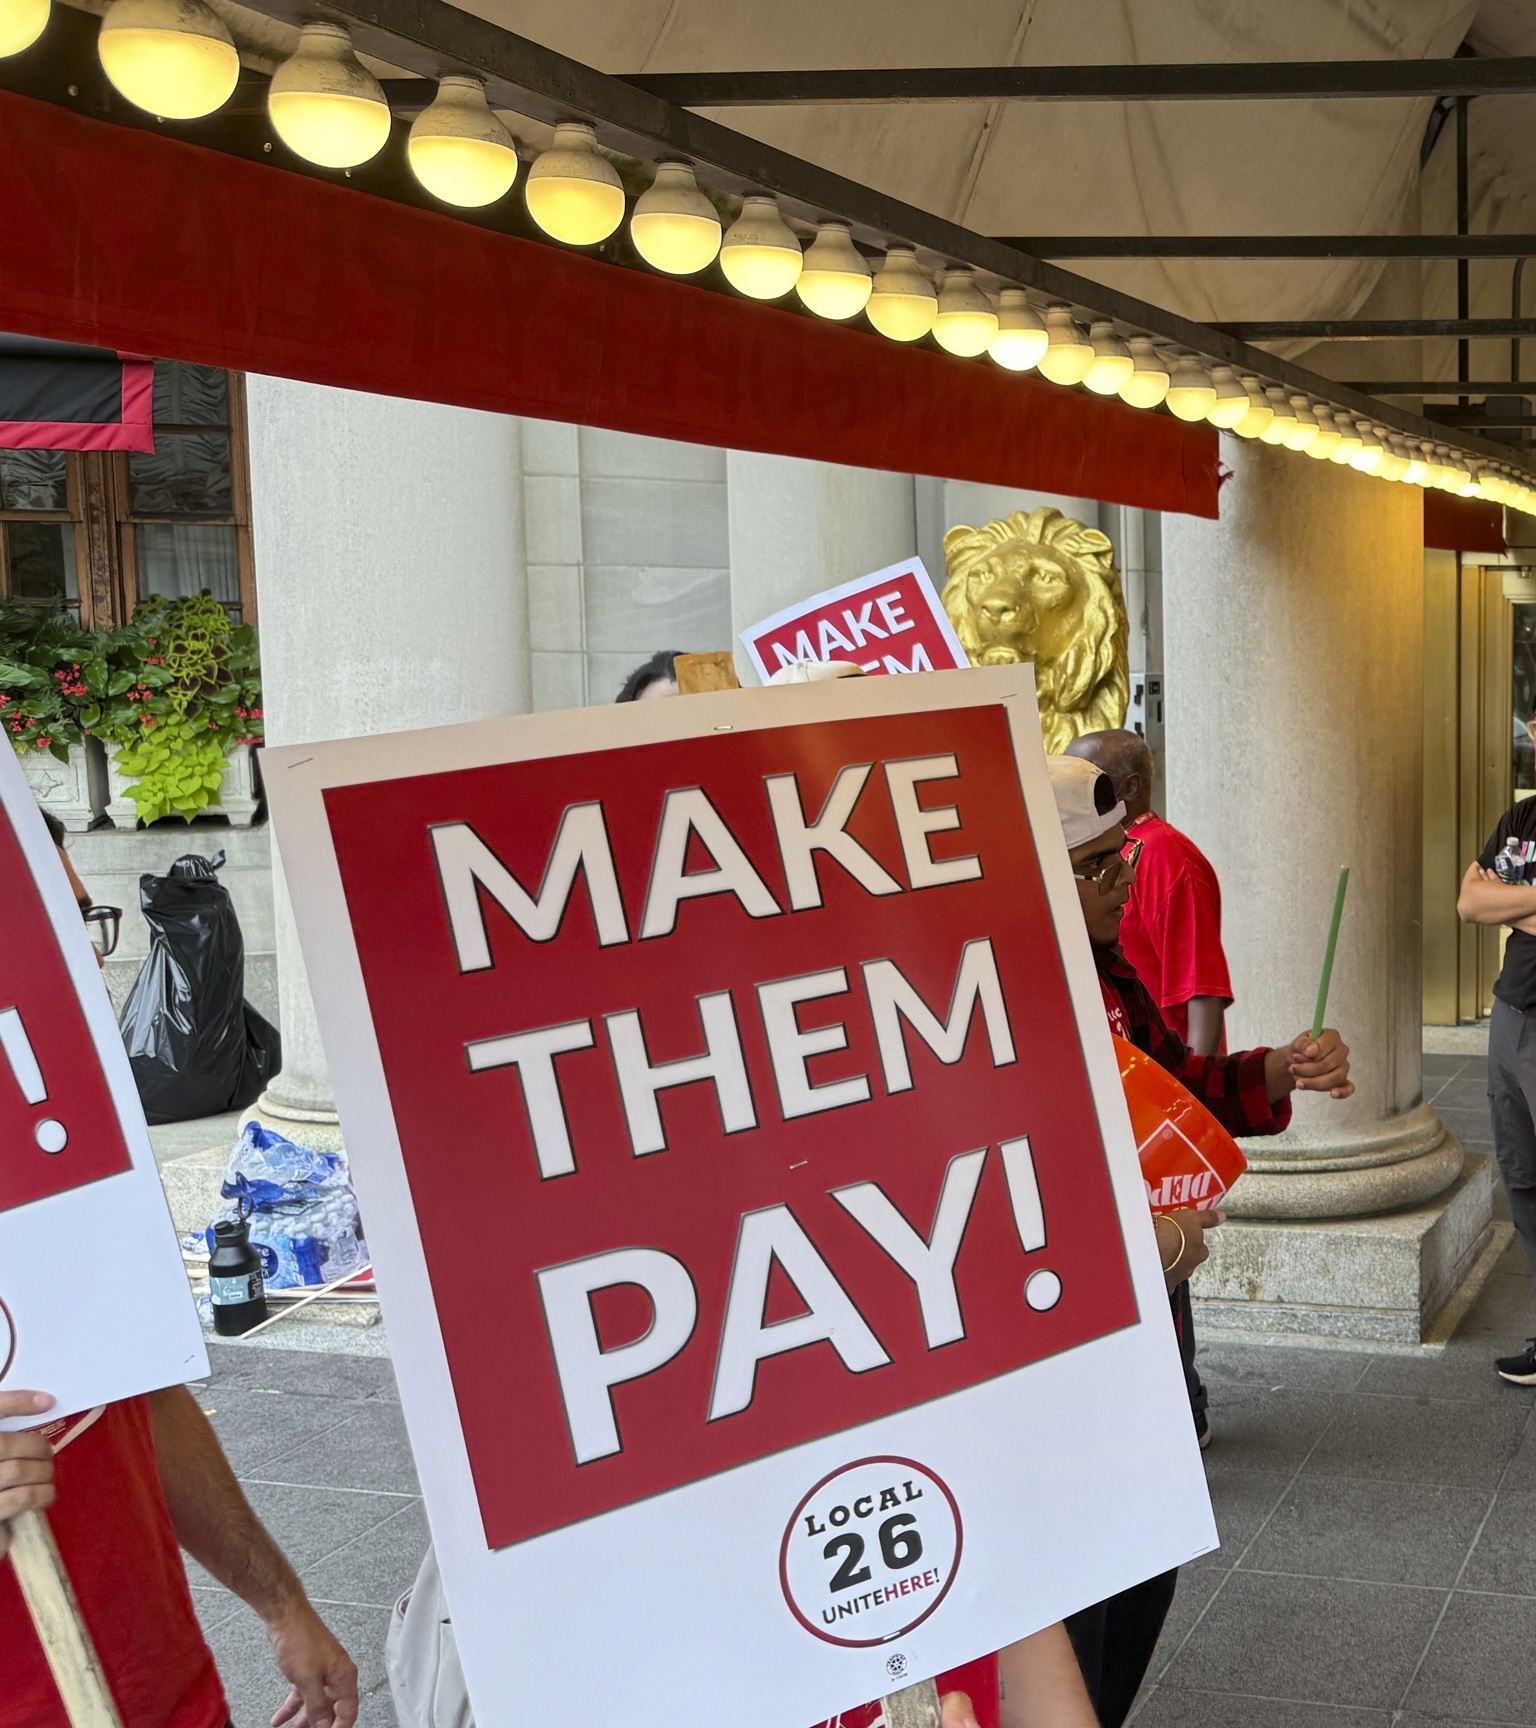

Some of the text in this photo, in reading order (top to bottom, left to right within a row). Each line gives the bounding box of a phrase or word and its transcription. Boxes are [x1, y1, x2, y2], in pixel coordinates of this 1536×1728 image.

[771, 591, 915, 669] MAKE
[428, 752, 983, 973] MAKE
[463, 936, 1018, 1181] THEM
[533, 1136, 1064, 1467] PAY!
[804, 1480, 923, 1537] LOCAL
[823, 1513, 923, 1593] 26
[822, 1567, 941, 1624] UNITEHERE!
